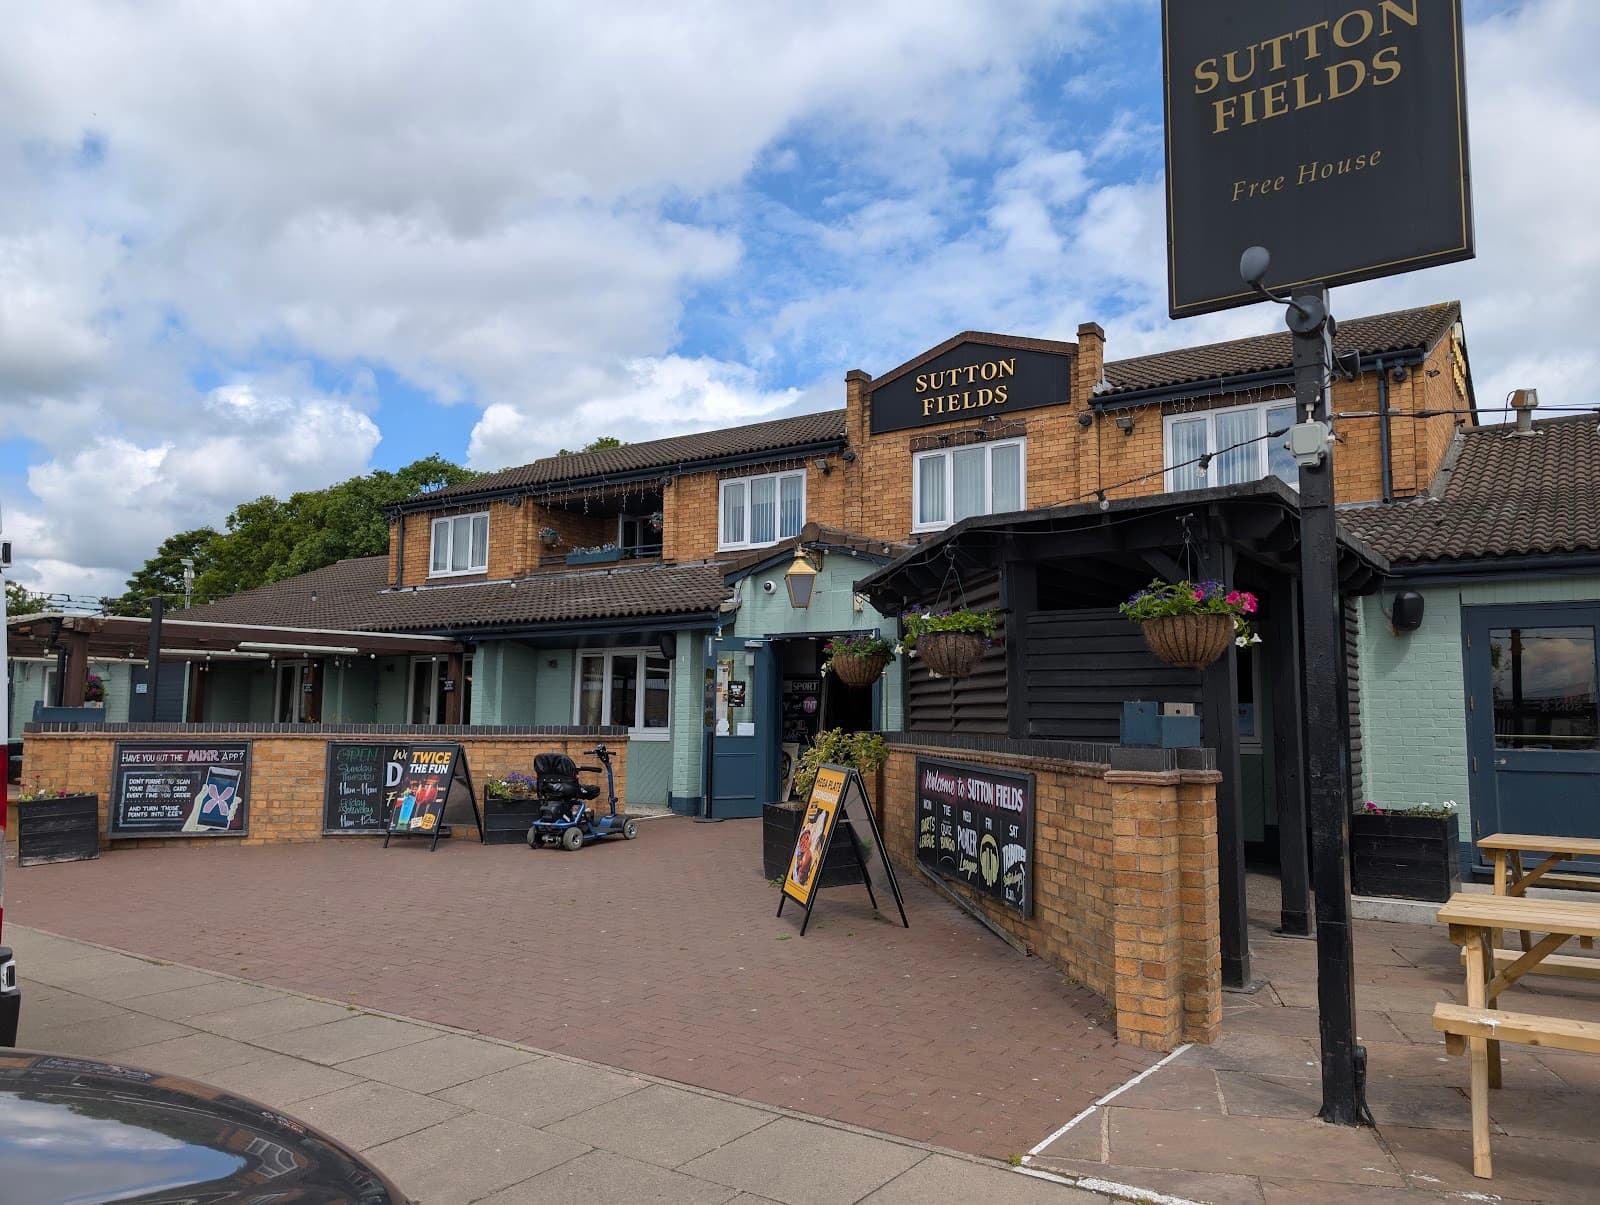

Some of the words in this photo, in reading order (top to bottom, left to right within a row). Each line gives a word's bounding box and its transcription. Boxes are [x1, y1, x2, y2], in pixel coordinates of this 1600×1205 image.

[1194, 0, 1418, 94] SUTTON
[1211, 46, 1402, 134] FIELDS
[1231, 175, 1285, 202] Free
[1296, 149, 1382, 185] House
[914, 357, 1016, 393] SUTTON
[922, 385, 1008, 417] FIELDS
[792, 681, 818, 691] SPORT
[122, 752, 140, 763] HAVE
[142, 753, 156, 762] YOU
[170, 753, 183, 762] THE
[336, 747, 380, 761] OPEN
[412, 751, 452, 764] TWICE
[410, 764, 428, 774] THE
[428, 764, 449, 774] FUN
[925, 769, 955, 795] Welcome
[957, 777, 966, 798] to
[967, 778, 994, 805] SUTTON
[995, 784, 1024, 813] FIELDS
[920, 815, 936, 833] DARTS
[940, 823, 953, 837] QUIZ
[985, 816, 993, 831] FRI
[1008, 824, 1019, 839] SAT
[940, 836, 956, 852] BINGO
[957, 824, 978, 859] POKER
